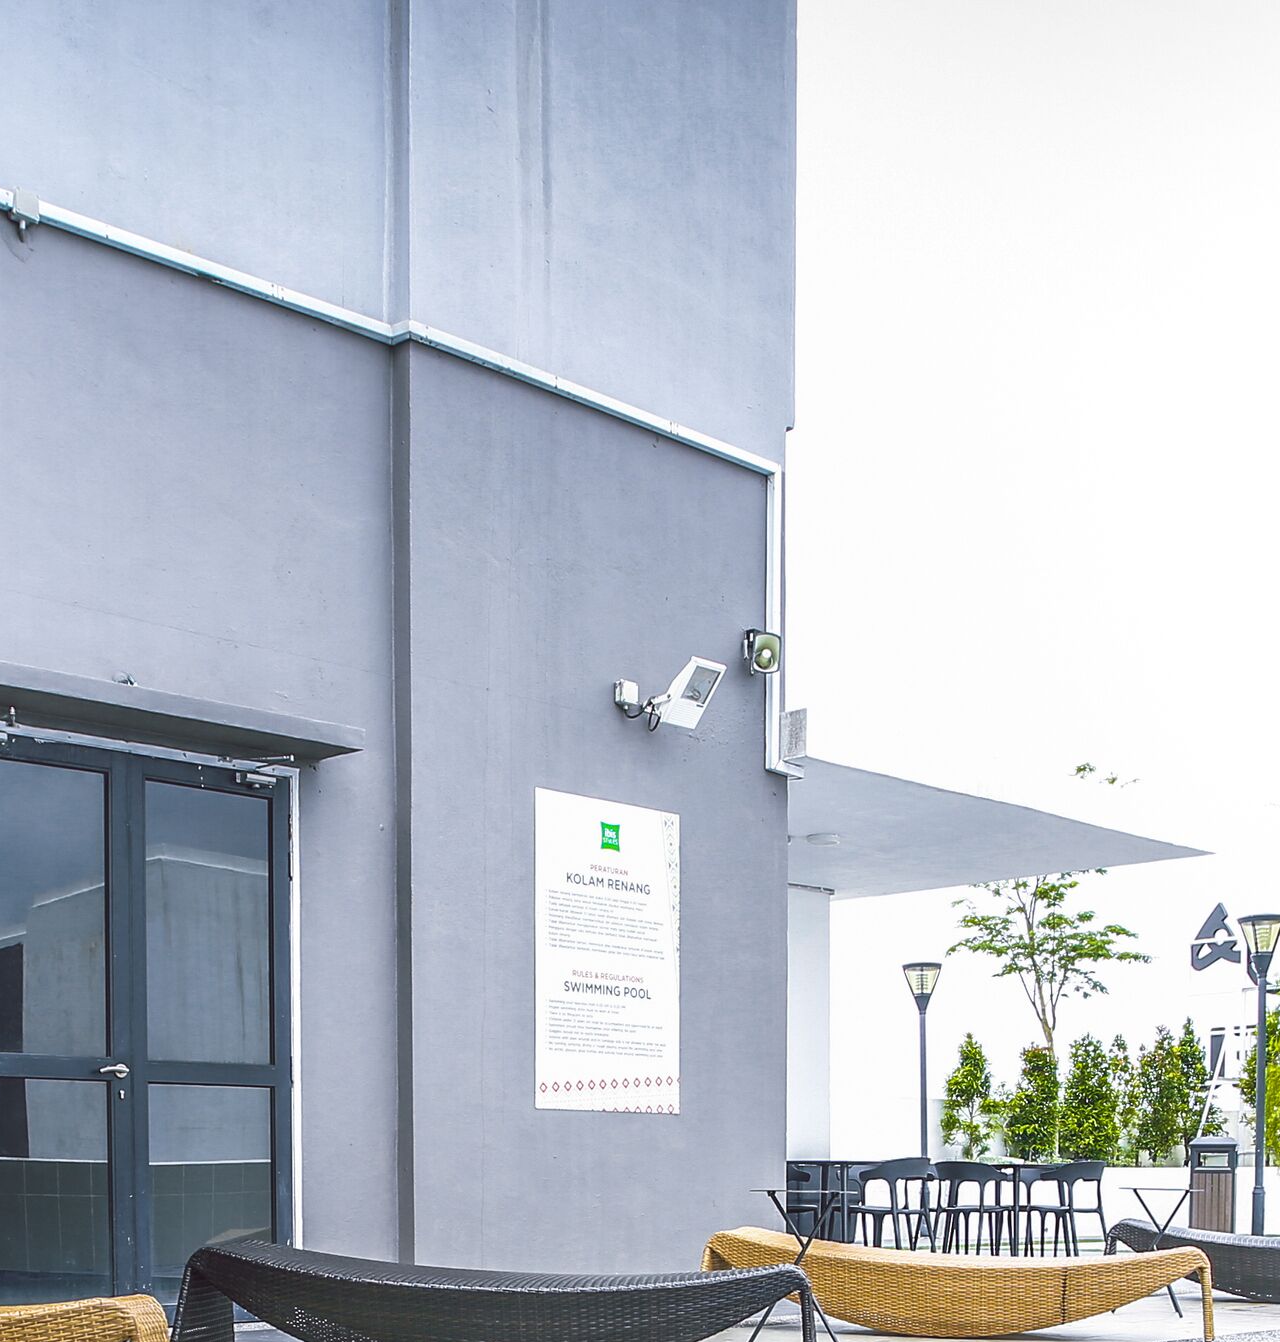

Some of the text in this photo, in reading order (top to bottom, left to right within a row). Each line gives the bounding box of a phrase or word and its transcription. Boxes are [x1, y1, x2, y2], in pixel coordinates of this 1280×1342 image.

[590, 863, 629, 876] PERATURAN
[566, 872, 651, 895] KOLAM RENANG
[572, 969, 593, 979] RULES
[600, 972, 644, 983] REGULATIONS
[564, 981, 651, 999] SWIMMING POOL
